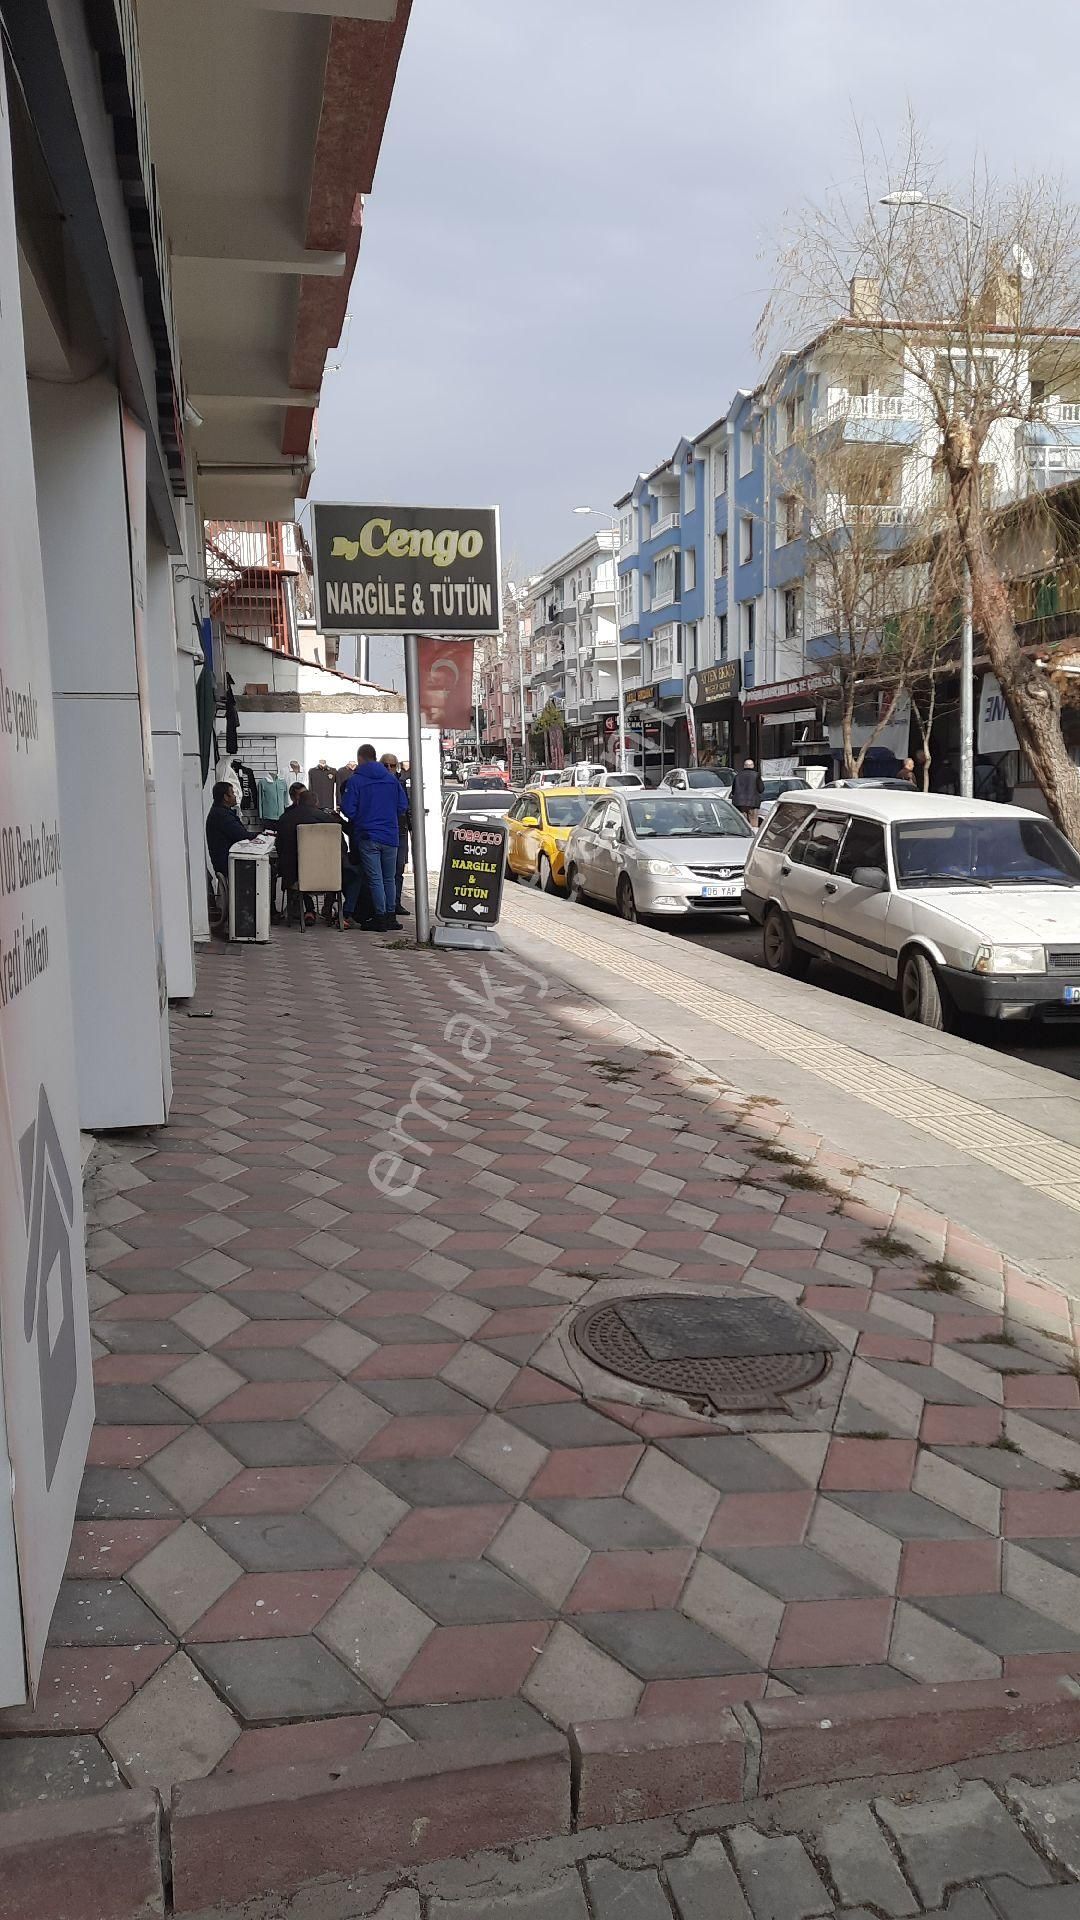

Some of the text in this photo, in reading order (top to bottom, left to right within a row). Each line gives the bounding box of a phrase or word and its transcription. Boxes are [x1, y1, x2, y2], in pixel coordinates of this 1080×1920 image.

[359, 517, 484, 567] Cengo
[326, 575, 492, 616] NARGİLE & TÜTÜN
[453, 828, 502, 845] TOBACCO
[16, 824, 42, 888] Banka
[463, 844, 488, 856] SHOP
[451, 859, 497, 873] NARGİLE
[468, 874, 477, 884] &
[453, 884, 489, 899] TÜTÜN
[21, 911, 49, 986] İmkanı
